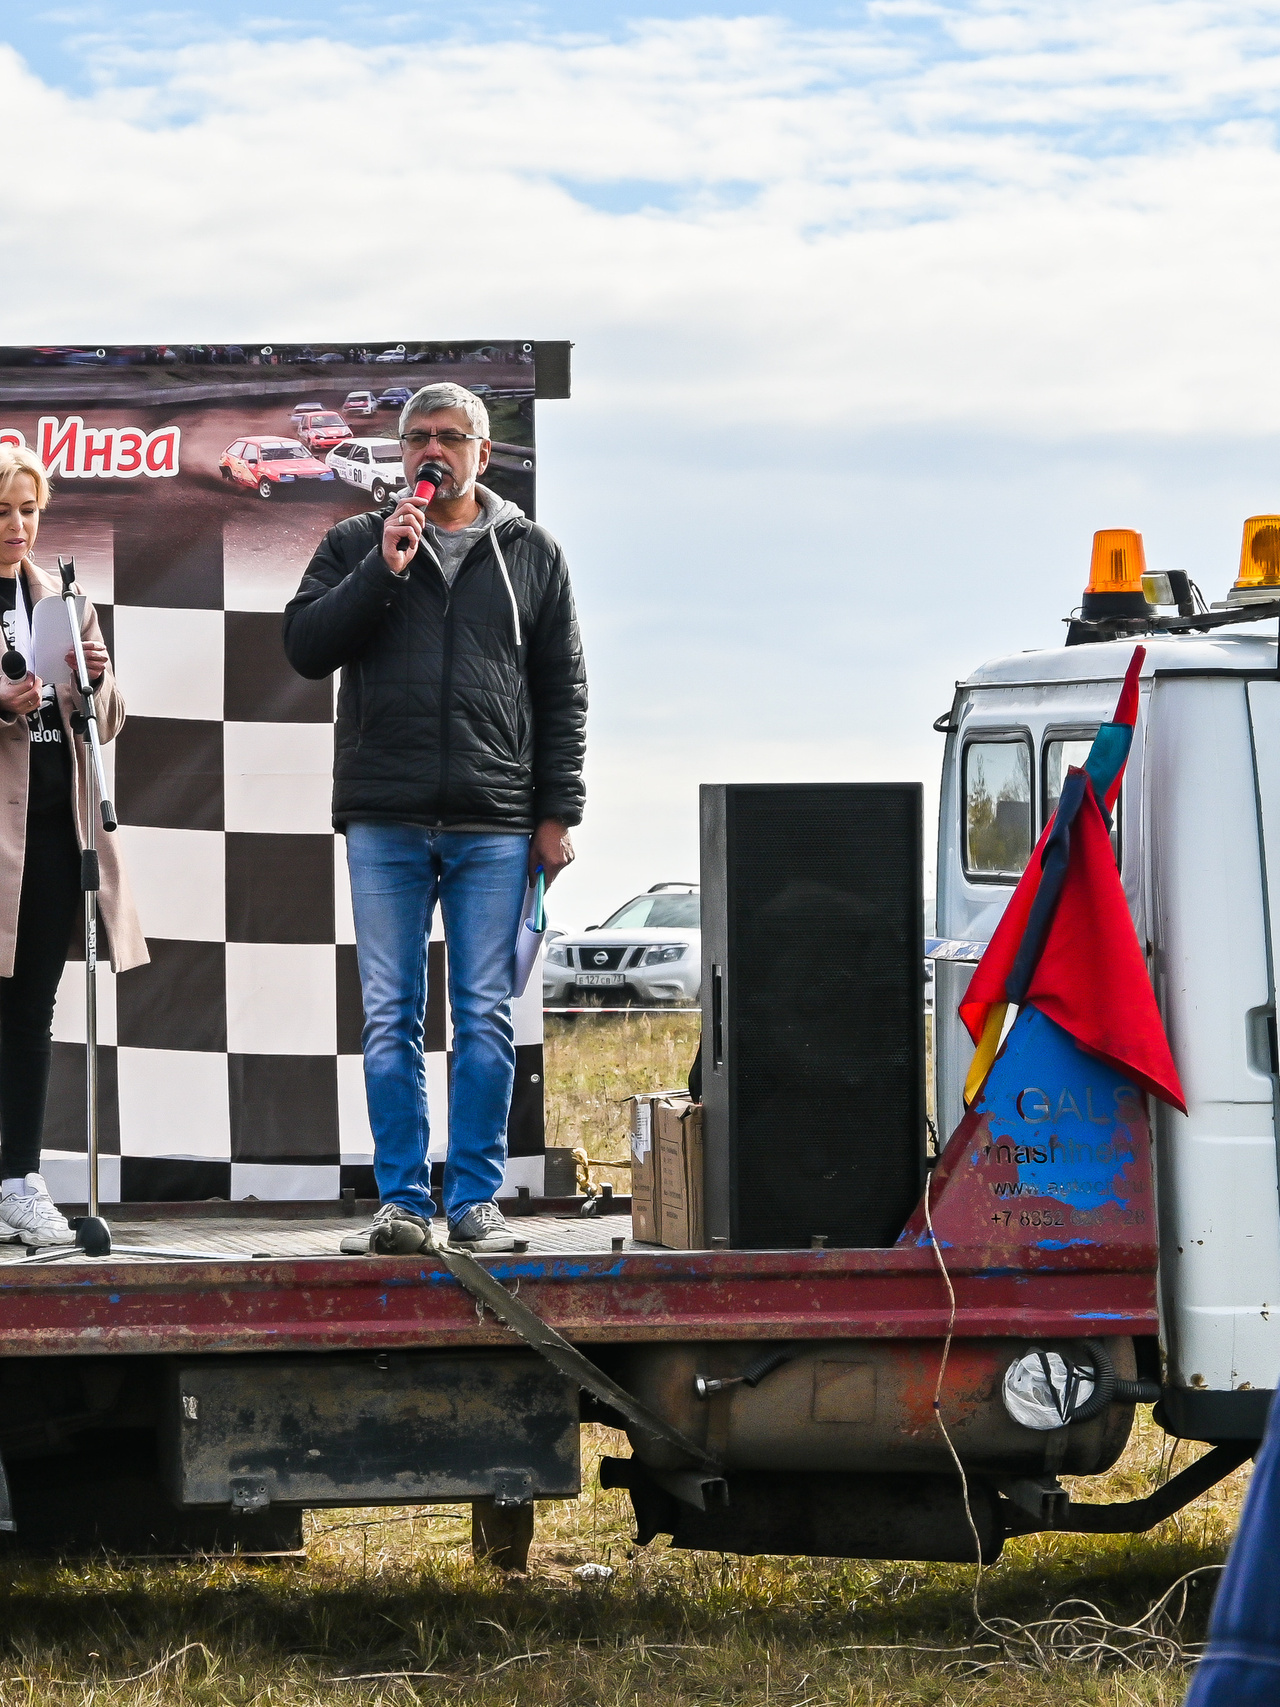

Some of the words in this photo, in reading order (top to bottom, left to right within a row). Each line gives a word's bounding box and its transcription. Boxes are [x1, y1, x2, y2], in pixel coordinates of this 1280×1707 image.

[39, 417, 179, 477] Инза
[353, 468, 363, 484] 60
[1015, 1085, 1141, 1125] GALS
[985, 1134, 1141, 1165] mashinery
[1019, 1210, 1065, 1227] 8352
